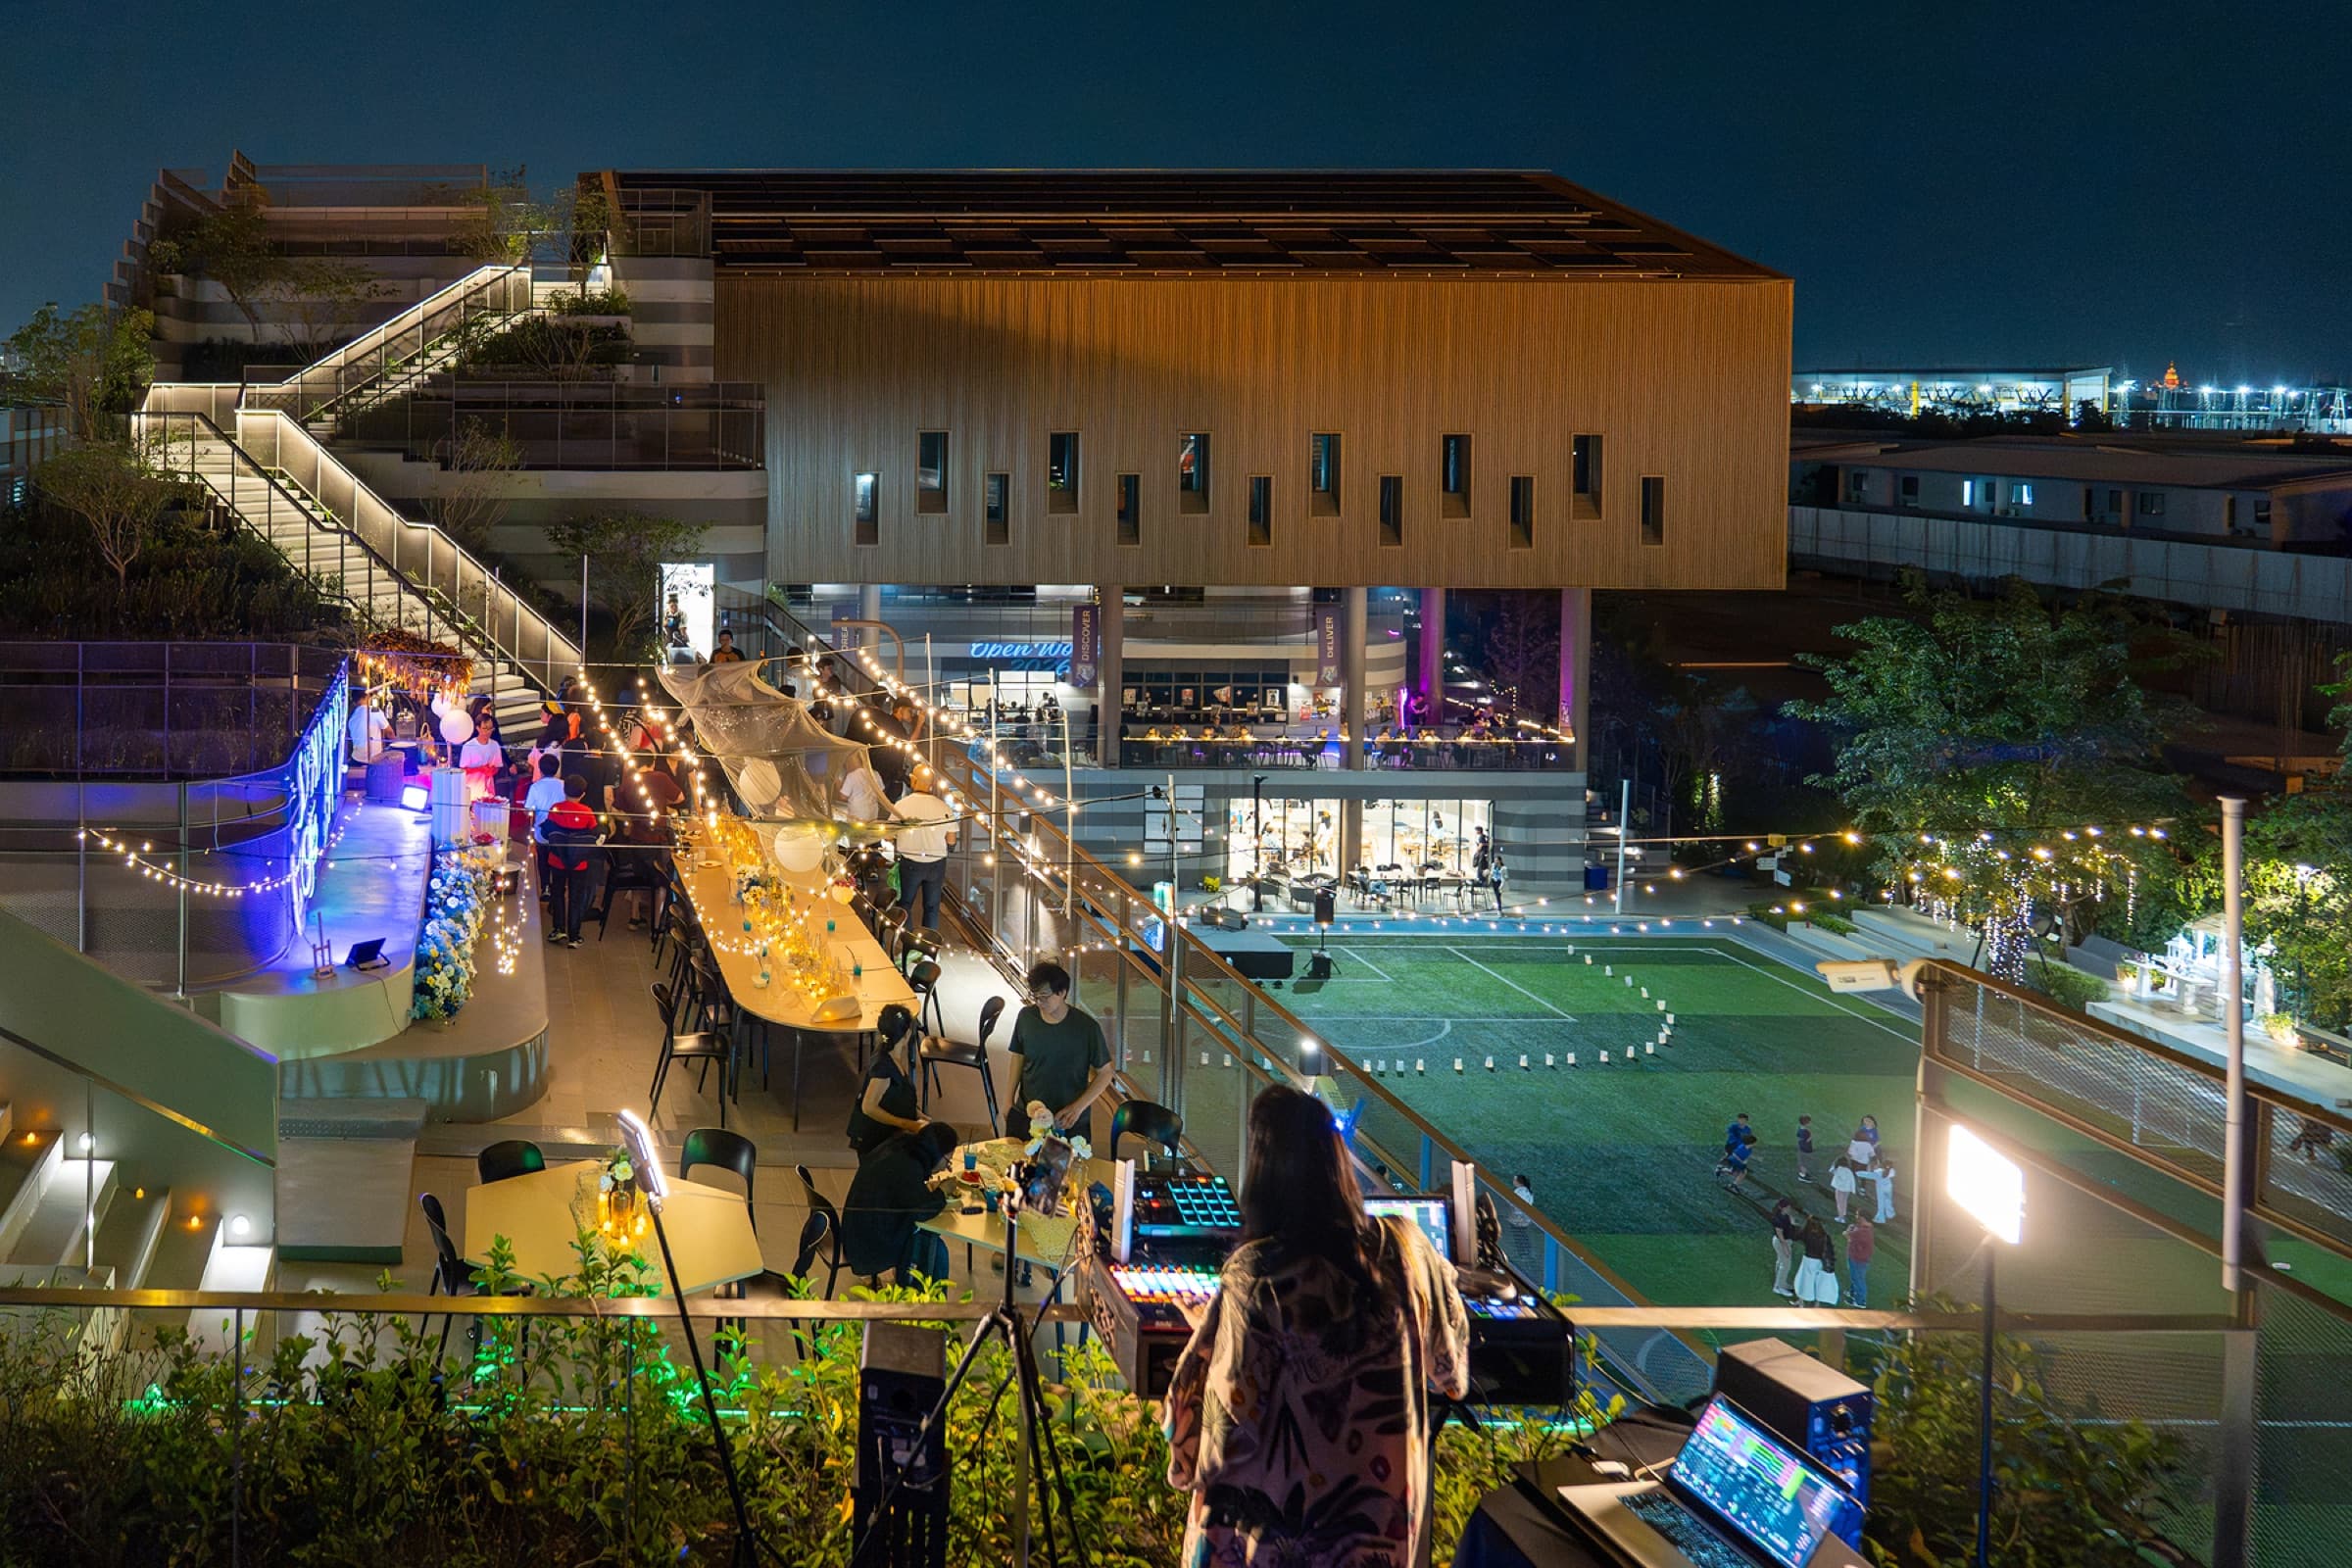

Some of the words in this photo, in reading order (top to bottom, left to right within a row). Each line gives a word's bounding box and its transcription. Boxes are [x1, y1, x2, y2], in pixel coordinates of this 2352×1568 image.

[971, 642, 1032, 660] Open
[1082, 610, 1091, 661] DISCOVER
[1325, 615, 1334, 659] DELIVER
